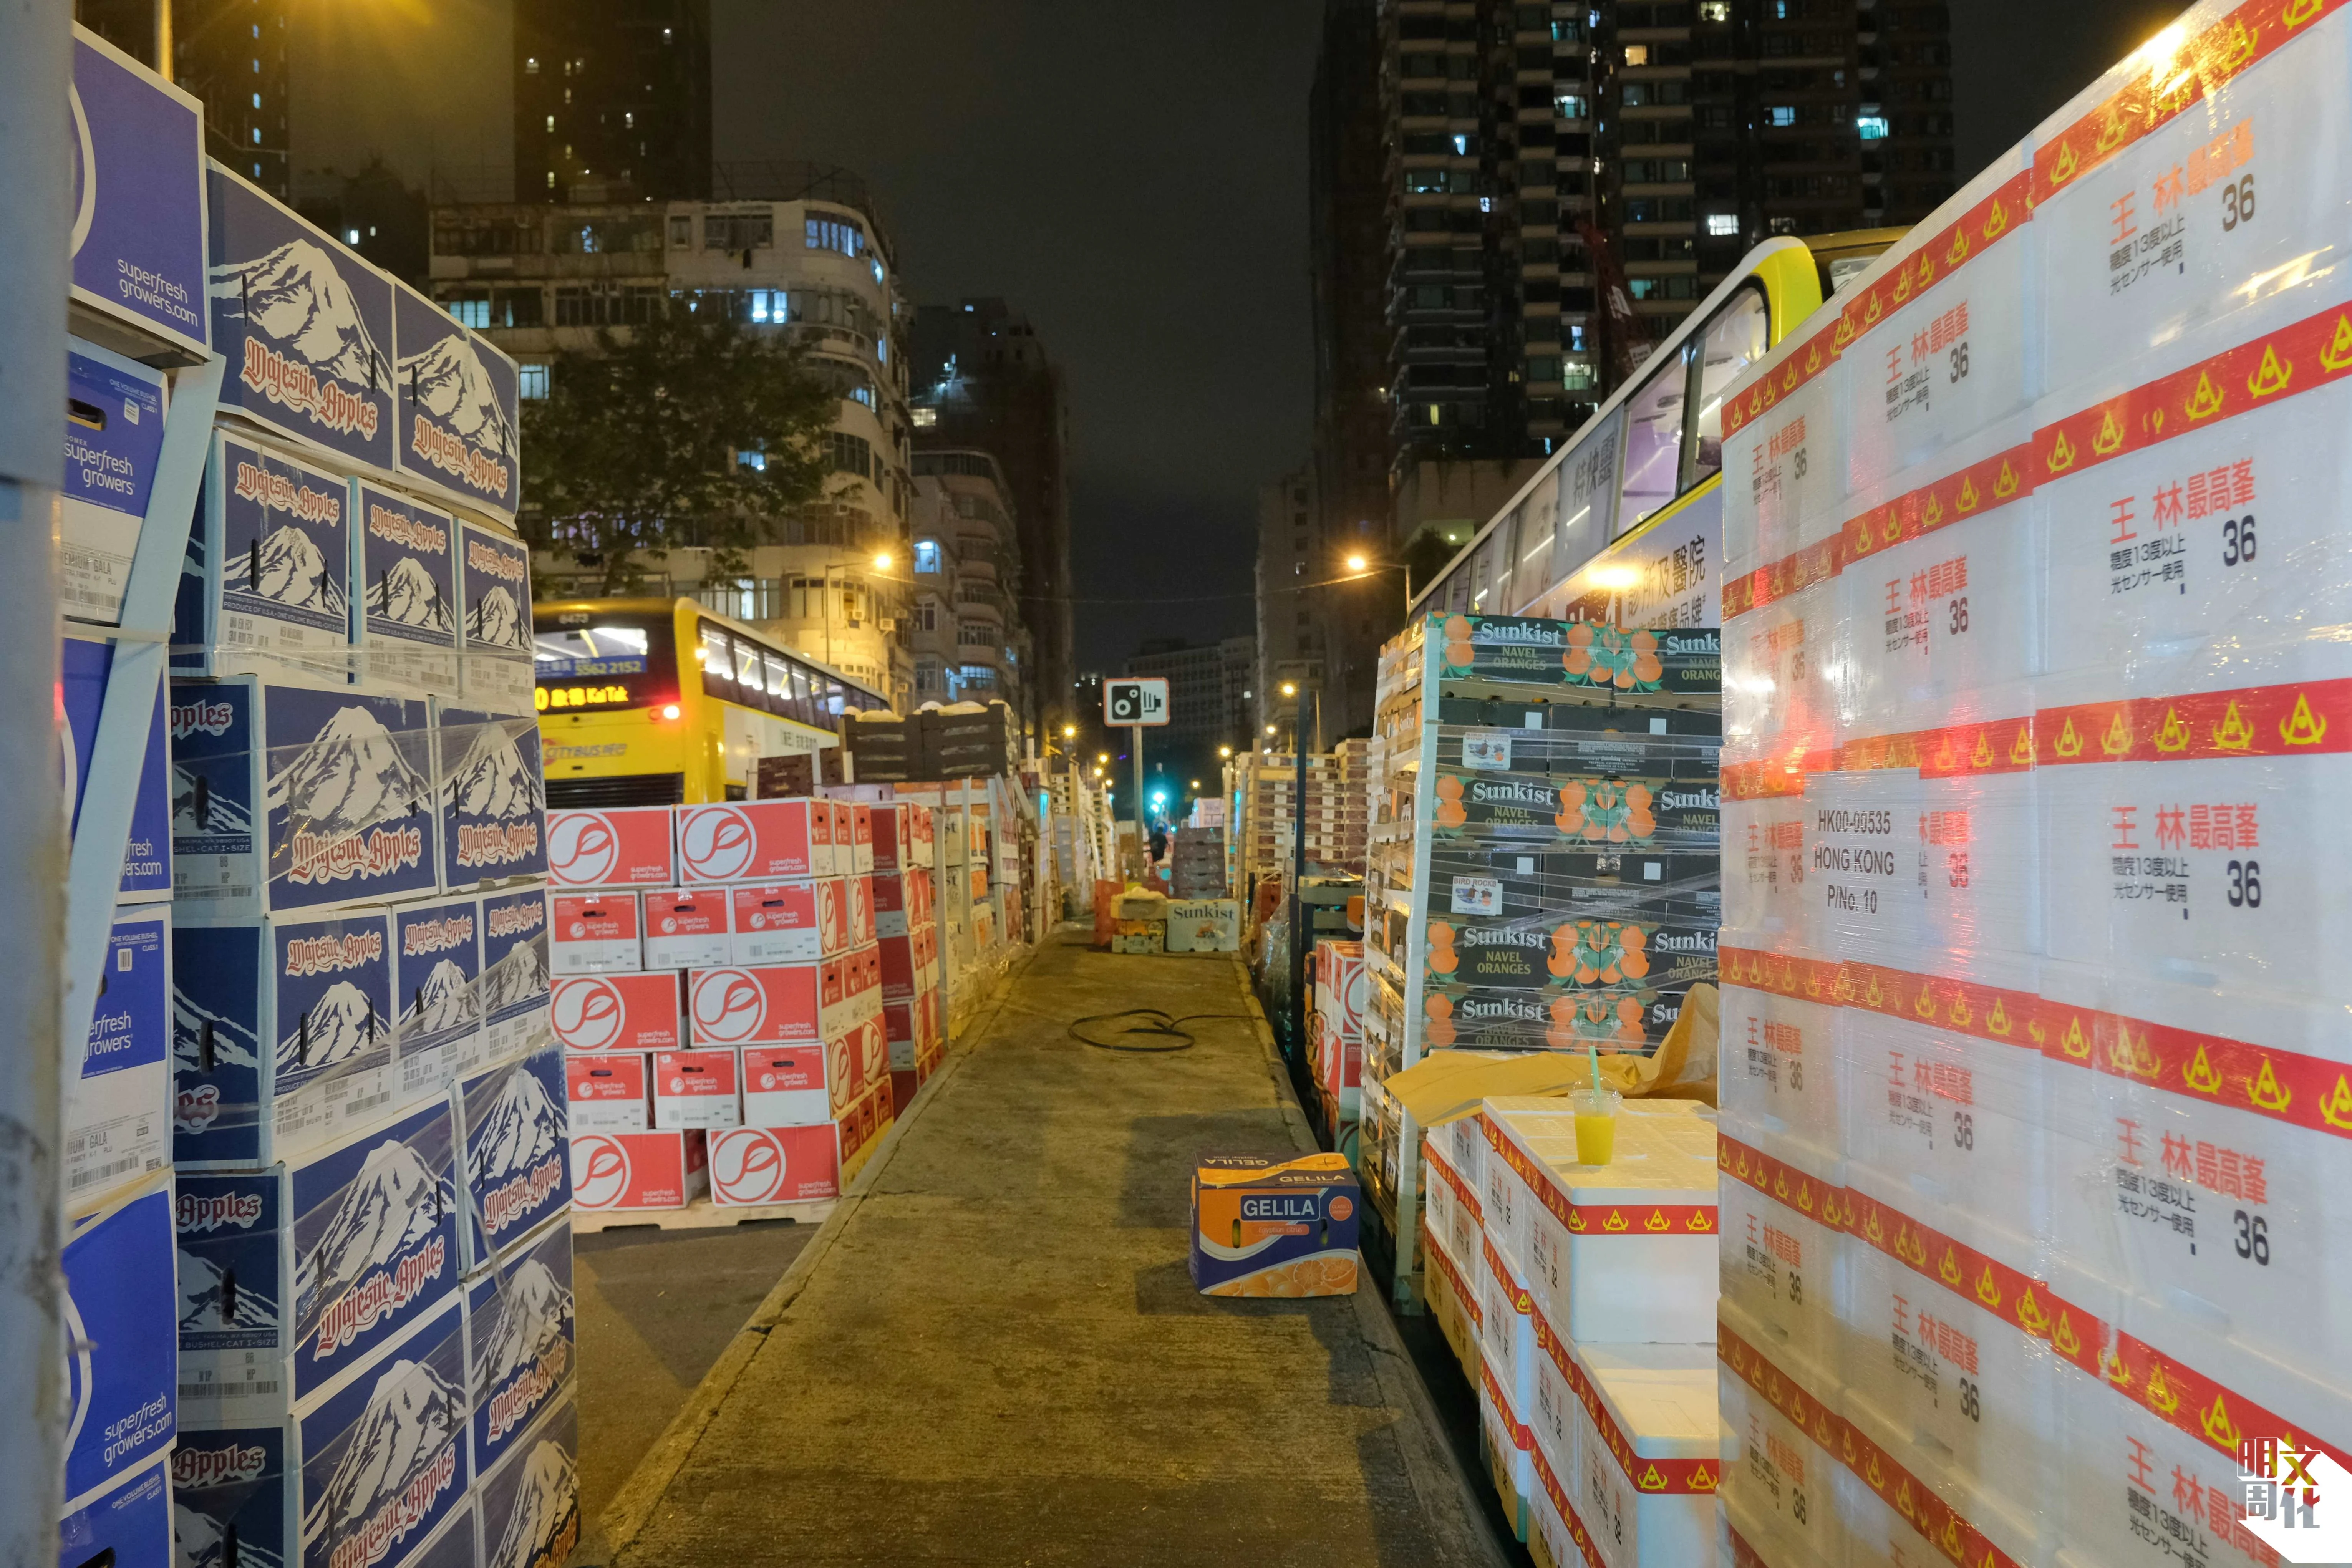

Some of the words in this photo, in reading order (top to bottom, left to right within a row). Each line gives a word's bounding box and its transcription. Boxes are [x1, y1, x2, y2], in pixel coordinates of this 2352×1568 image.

[2110, 191, 2137, 245] 王
[2222, 174, 2255, 232] 36
[118, 258, 188, 304] superfresh
[119, 278, 198, 327] growers.com
[1886, 345, 1902, 385] 王
[1949, 341, 1969, 384] 36
[244, 338, 318, 412] Majestic
[320, 383, 377, 431] Apples
[64, 443, 133, 477] superfresh
[413, 416, 467, 474] Majestic
[470, 452, 508, 493] Apples
[1752, 443, 1763, 476] 王
[1794, 447, 1807, 481] 36
[83, 469, 134, 496] growers
[236, 463, 296, 510] Majestic
[297, 487, 339, 522] Apples
[370, 506, 412, 539] Majestic
[413, 520, 446, 551] Apples
[2110, 496, 2137, 545] 王
[2223, 515, 2256, 567] 36
[94, 559, 111, 575] GALA
[469, 542, 499, 571] Majestic
[500, 553, 524, 579] Apples
[224, 602, 252, 612] PRODUCE
[1885, 578, 1901, 615] 王
[1949, 597, 1968, 635] 36
[1480, 622, 1561, 647] Sunkist
[1493, 657, 1546, 671] ORANGES
[1502, 646, 1538, 659] NAVEL
[1792, 651, 1805, 681] 36
[1472, 782, 1554, 807] Sunkist
[1485, 817, 1538, 830] ORANGES
[1494, 807, 1530, 819] NAVEL
[1818, 809, 1891, 835] HK00-00535
[2111, 806, 2139, 849] 王
[290, 833, 365, 880] Majestic
[367, 827, 421, 870] Apples
[457, 825, 504, 864] Majestic
[504, 823, 537, 856] Apples
[1748, 825, 1758, 852] 王
[630, 866, 663, 875] superfresh
[630, 872, 668, 880] growers.com
[769, 858, 802, 868] superfresh
[769, 864, 806, 873] growers.com
[1790, 855, 1803, 885] 36
[1815, 847, 1850, 871] HONG
[1855, 849, 1894, 876] KONG
[1454, 878, 1471, 886] BIRD
[1473, 878, 1497, 887] ROCKS
[2227, 860, 2261, 908] 36
[1174, 904, 1235, 922] Sunkist
[1828, 885, 1859, 912] P/No.
[1865, 889, 1877, 914] 10
[404, 923, 443, 954] Majestic
[444, 916, 473, 945] Apples
[490, 908, 520, 935] Majestic
[521, 902, 544, 928] Apples
[287, 940, 340, 973] Majestic
[343, 932, 381, 963] Apples
[1464, 927, 1546, 951] Sunkist
[1655, 933, 1718, 953] Sunki
[1477, 963, 1531, 975] ORANGES
[1486, 951, 1522, 963] NAVEL
[1676, 956, 1713, 968] NAVEL
[779, 1022, 811, 1032] superfresh
[1462, 999, 1544, 1022] Sunkist
[637, 1031, 670, 1039] superfresh
[637, 1036, 675, 1045] growers.com
[778, 1029, 815, 1037] growers.com
[1475, 1035, 1529, 1047] ORANGES
[1747, 1016, 1758, 1046] 王
[1789, 1060, 1803, 1091] 36
[1888, 1051, 1905, 1087] 王
[275, 1082, 300, 1093] PRODUCE
[90, 1132, 108, 1149] GALA
[1954, 1111, 1973, 1151] 36
[2116, 1117, 2144, 1169] 王
[484, 1179, 530, 1230] Majestic
[530, 1156, 561, 1202] Apples
[642, 1189, 675, 1198] superfresh
[798, 1180, 832, 1190] superfresh
[798, 1187, 836, 1196] growers.com
[1279, 1174, 1345, 1182] GELILA
[176, 1195, 260, 1228] Apples
[642, 1195, 680, 1204] growers.com
[1243, 1199, 1315, 1217] GELILA
[1747, 1212, 1757, 1245] 王
[2234, 1208, 2270, 1266] 36
[317, 1277, 392, 1355] Majestic
[394, 1237, 444, 1301] Apples
[1789, 1271, 1802, 1306] 36
[1892, 1293, 1909, 1336] 王
[488, 1366, 537, 1437] Majestic
[535, 1339, 566, 1395] Apples
[1959, 1377, 1980, 1423] 36
[105, 1391, 166, 1441] superfresh
[104, 1411, 172, 1467] growers.com
[172, 1447, 264, 1482] Apples
[2127, 1435, 2156, 1496] 王
[403, 1445, 455, 1526] Apples
[1793, 1488, 1807, 1525] 36
